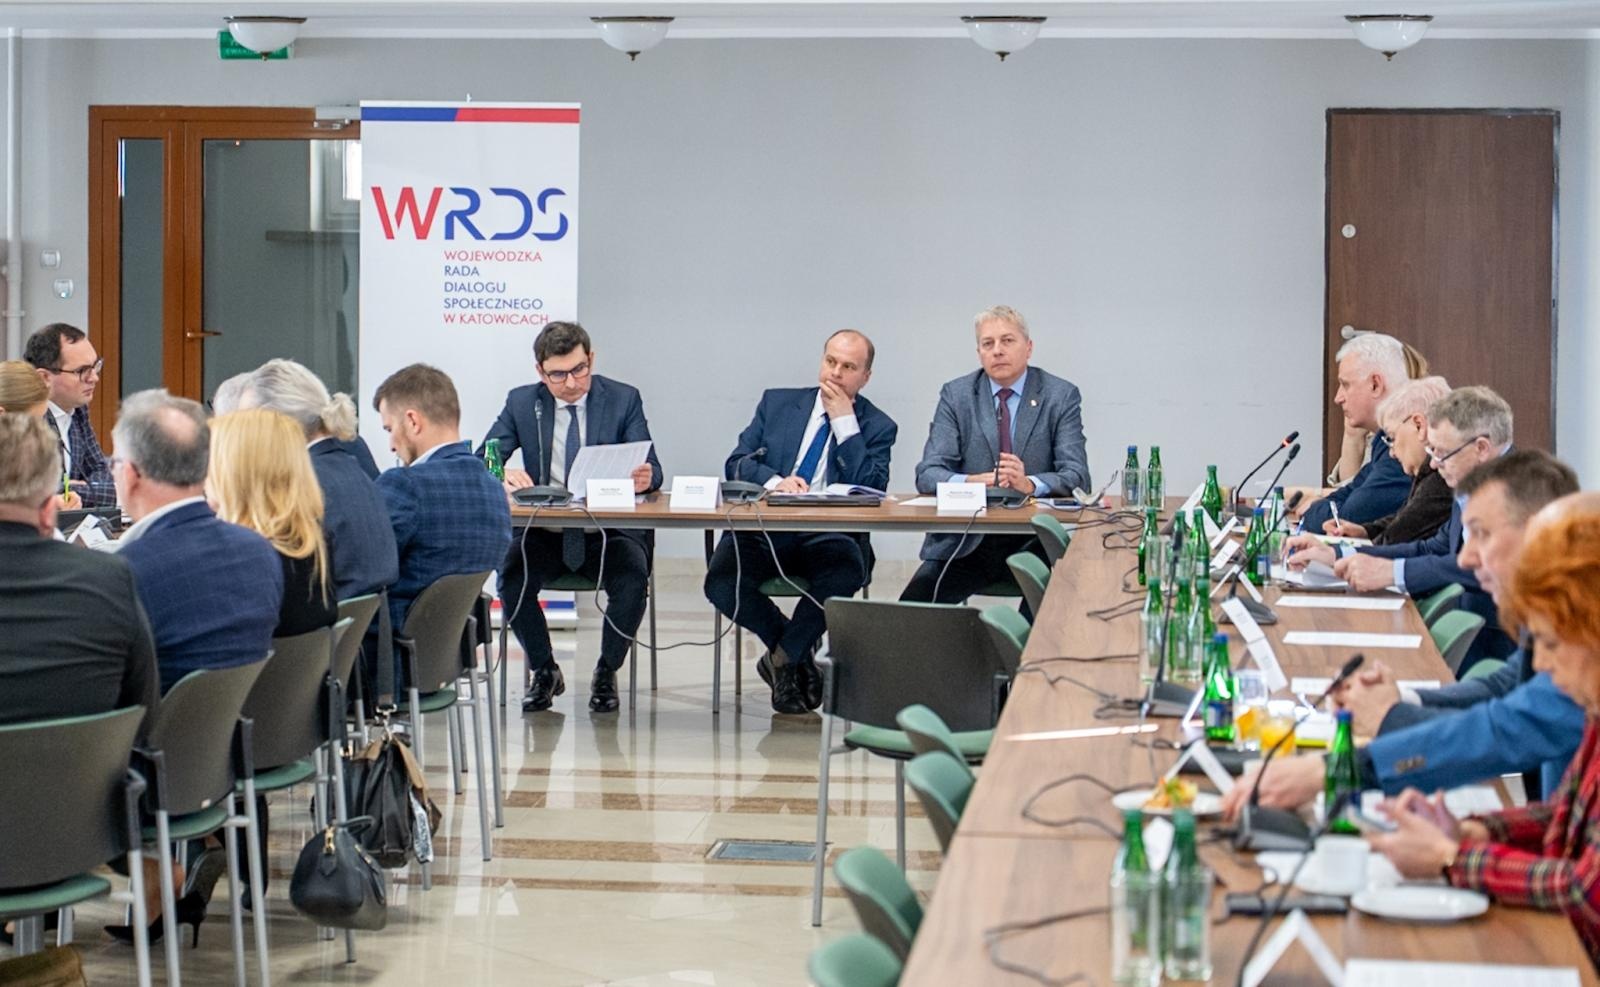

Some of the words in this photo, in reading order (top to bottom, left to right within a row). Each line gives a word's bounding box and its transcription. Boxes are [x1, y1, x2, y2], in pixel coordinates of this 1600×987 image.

[370, 186, 569, 242] WRDS
[444, 265, 480, 276] RADA
[444, 281, 506, 293] DIALOGU
[443, 298, 543, 310] SPOŁECZNEGO
[443, 313, 456, 324] W
[459, 313, 549, 325] KATOWICACH
